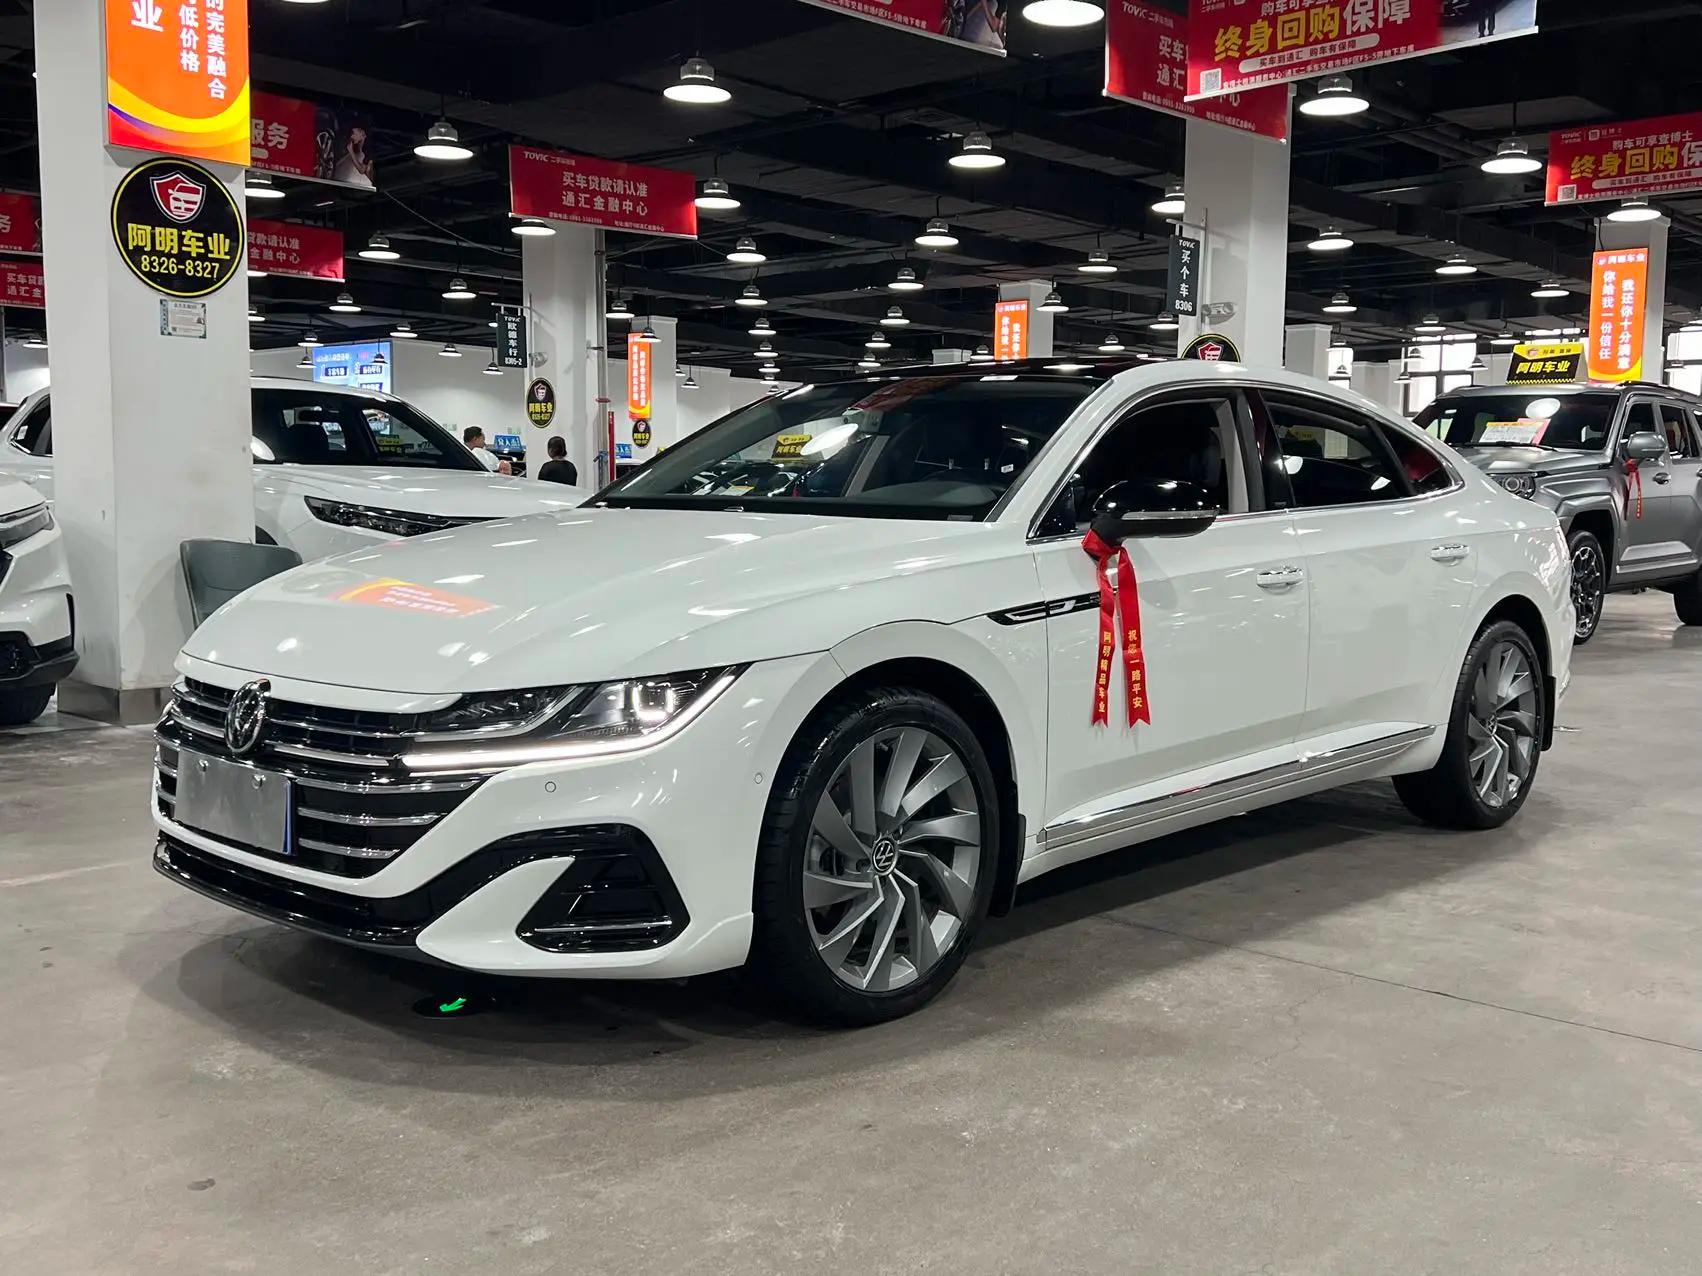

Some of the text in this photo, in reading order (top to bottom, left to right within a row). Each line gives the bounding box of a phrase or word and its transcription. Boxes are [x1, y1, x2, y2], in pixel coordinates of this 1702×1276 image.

[131, 0, 164, 32] 业
[1214, 0, 1411, 62] 终身回购保障
[178, 0, 201, 73] 低价格
[1158, 34, 1189, 64] 买车
[1156, 63, 1186, 92] 通汇
[1612, 129, 1694, 151] 购车可享查博士
[523, 151, 549, 162] TOVIC
[1570, 140, 1702, 180] 终身回购保
[562, 171, 648, 198] 买车贷款请认准
[562, 190, 648, 217] 通汇金融中心
[127, 222, 231, 260] 阿明车业
[140, 254, 220, 280] 8326-8327
[1180, 249, 1192, 298] 买个车
[1174, 299, 1193, 312] 8306
[1598, 269, 1616, 360] 你给我一份信任
[1617, 278, 1635, 370] 我还你十分满意
[1516, 360, 1571, 374] 阿明车业
